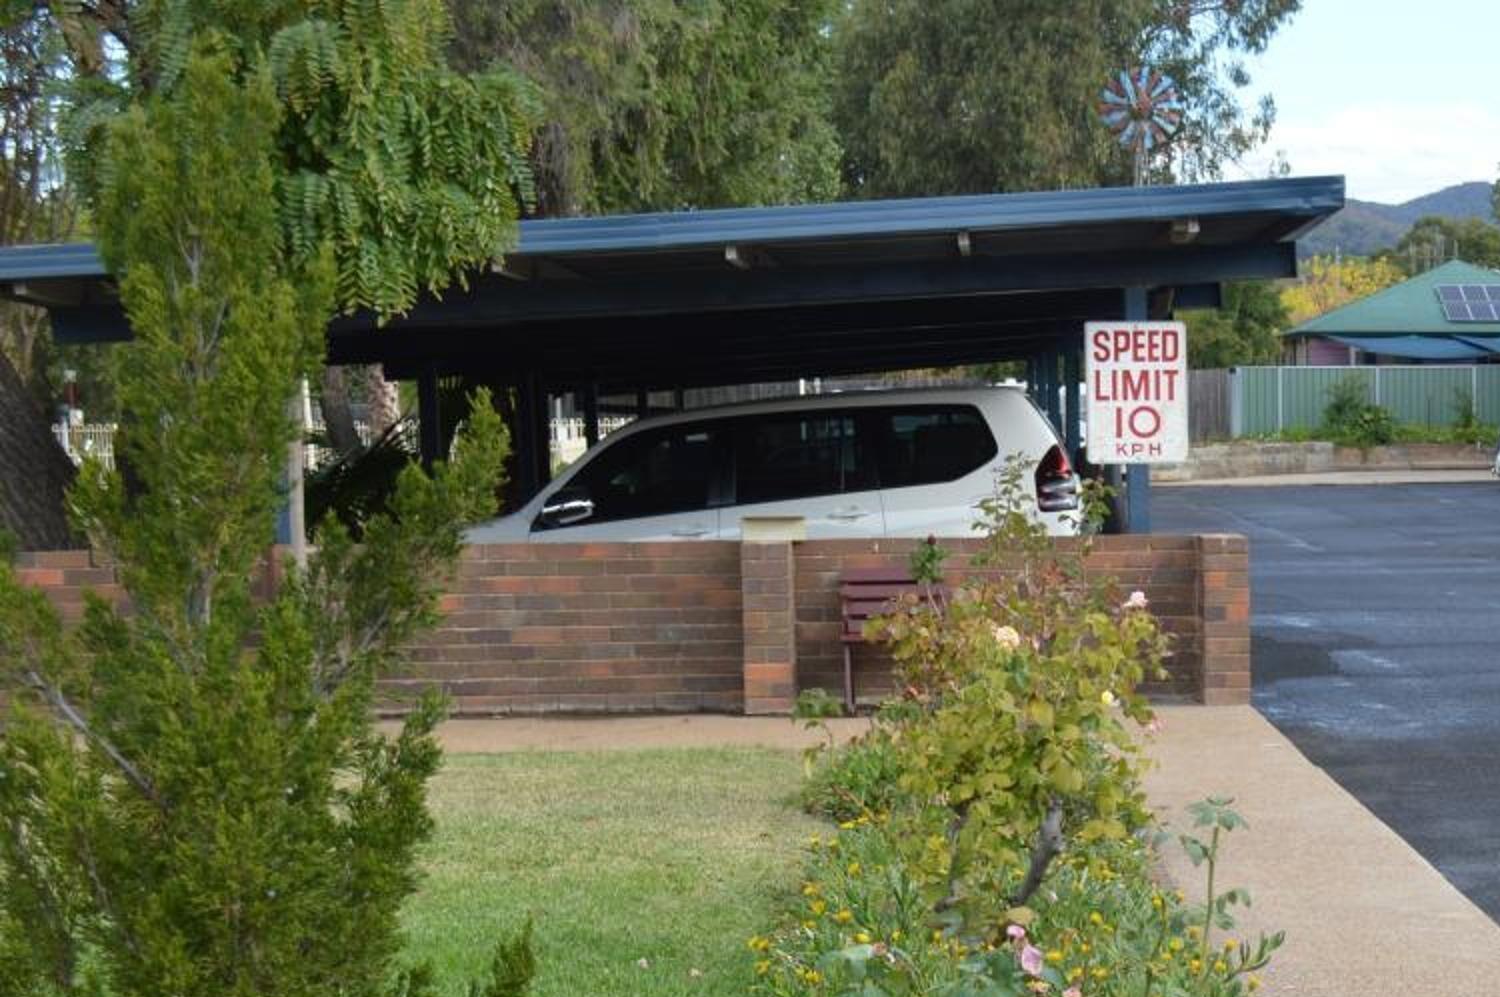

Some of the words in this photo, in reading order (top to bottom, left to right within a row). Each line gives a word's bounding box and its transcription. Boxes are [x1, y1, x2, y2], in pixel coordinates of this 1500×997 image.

[1093, 330, 1179, 362] SPEED
[1094, 369, 1178, 401] LIMIT
[1116, 406, 1161, 438] 10
[1116, 443, 1162, 456] KPH
